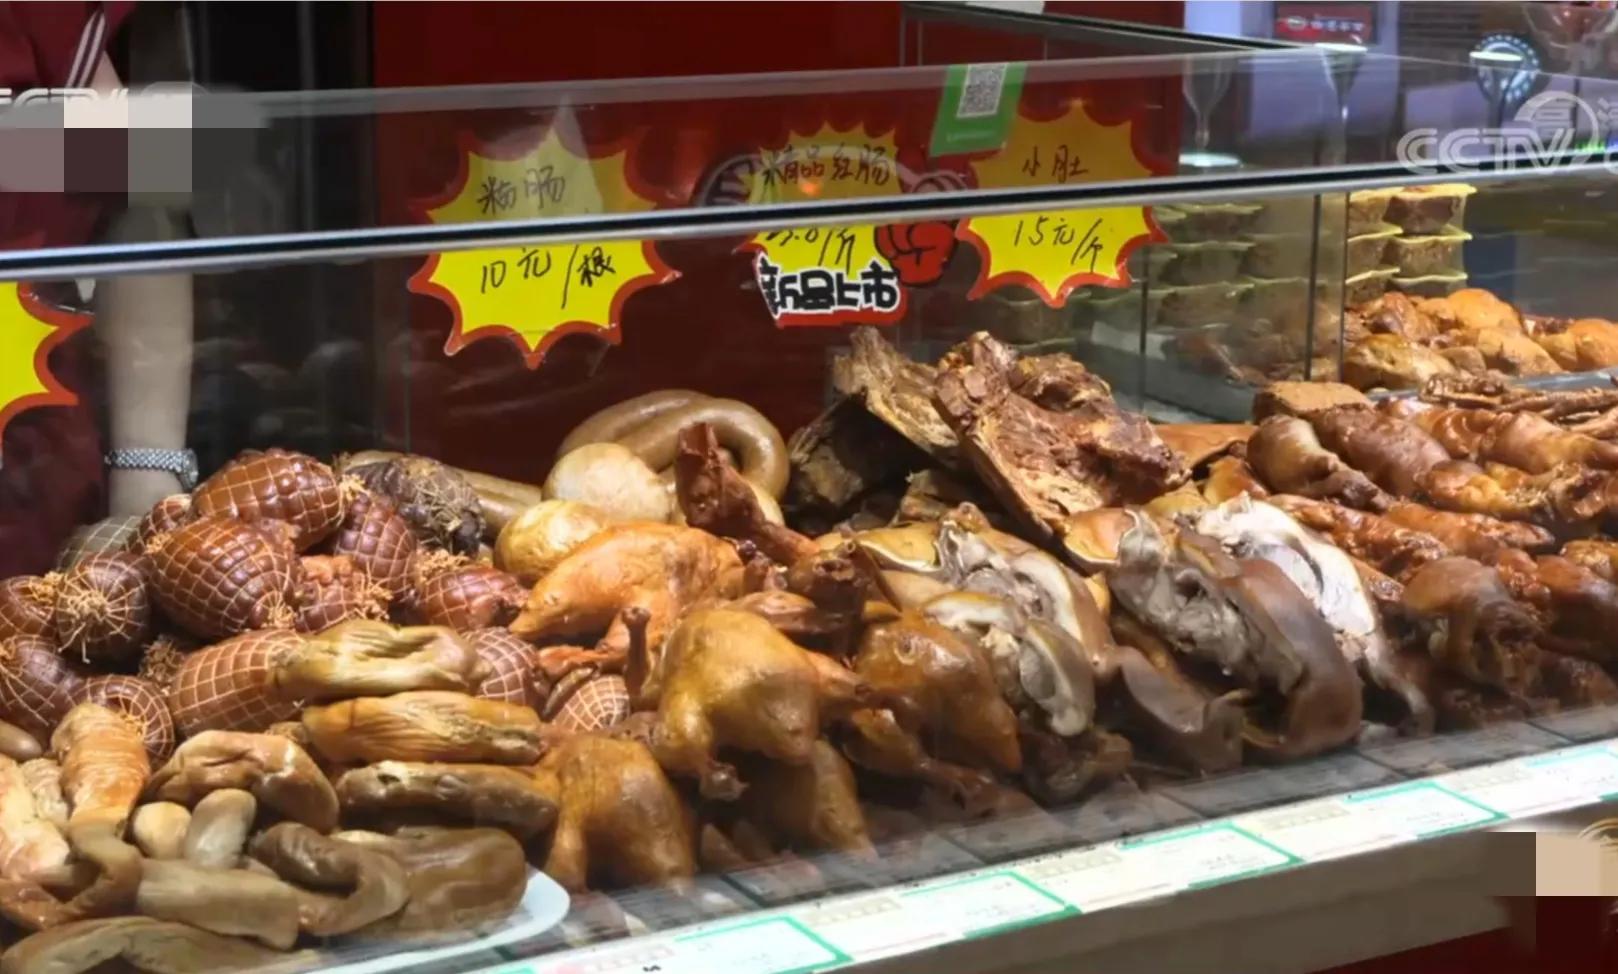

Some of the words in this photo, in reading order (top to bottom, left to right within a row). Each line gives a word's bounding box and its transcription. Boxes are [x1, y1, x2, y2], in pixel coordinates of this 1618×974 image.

[762, 143, 891, 187] 精品红肠
[1014, 215, 1104, 273] 15元/斤
[480, 245, 617, 310] 10元/根
[759, 256, 899, 317] 新品上市
